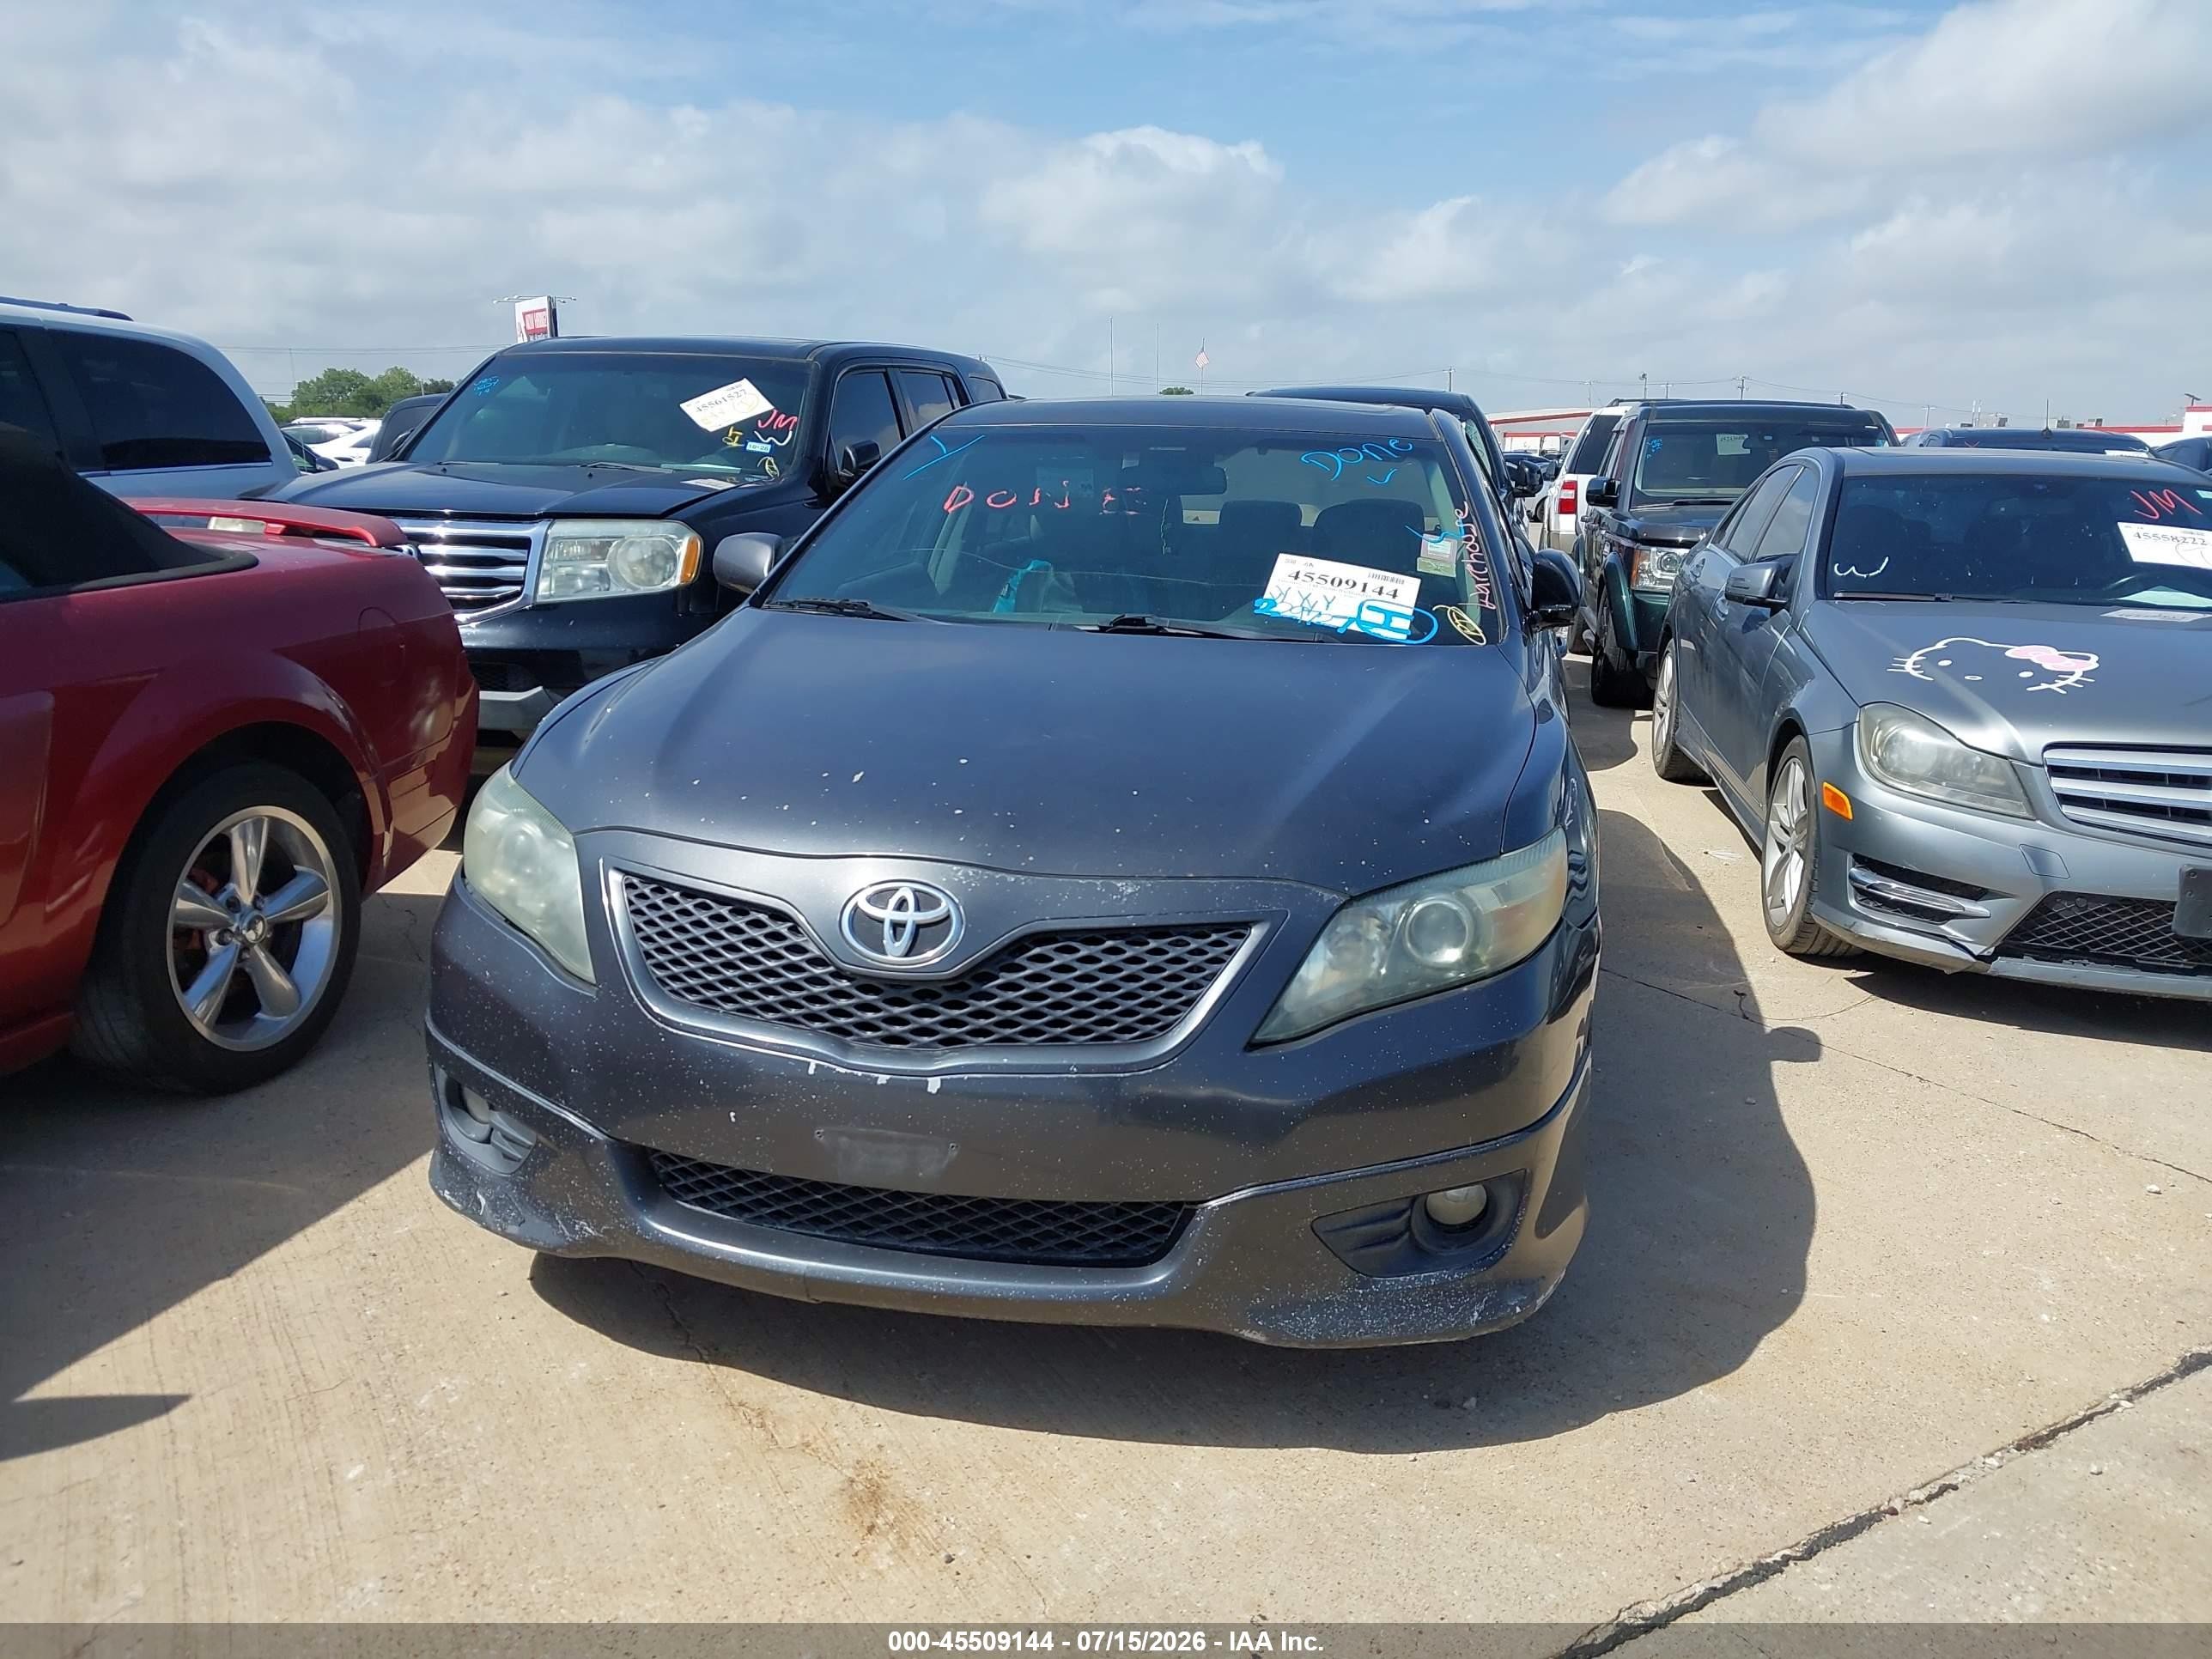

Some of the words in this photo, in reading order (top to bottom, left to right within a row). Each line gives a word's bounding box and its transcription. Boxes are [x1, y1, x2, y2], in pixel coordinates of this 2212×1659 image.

[1300, 438, 1413, 481] Done
[2133, 532, 2209, 546] 45558222
[1288, 569, 1400, 599] 45509144
